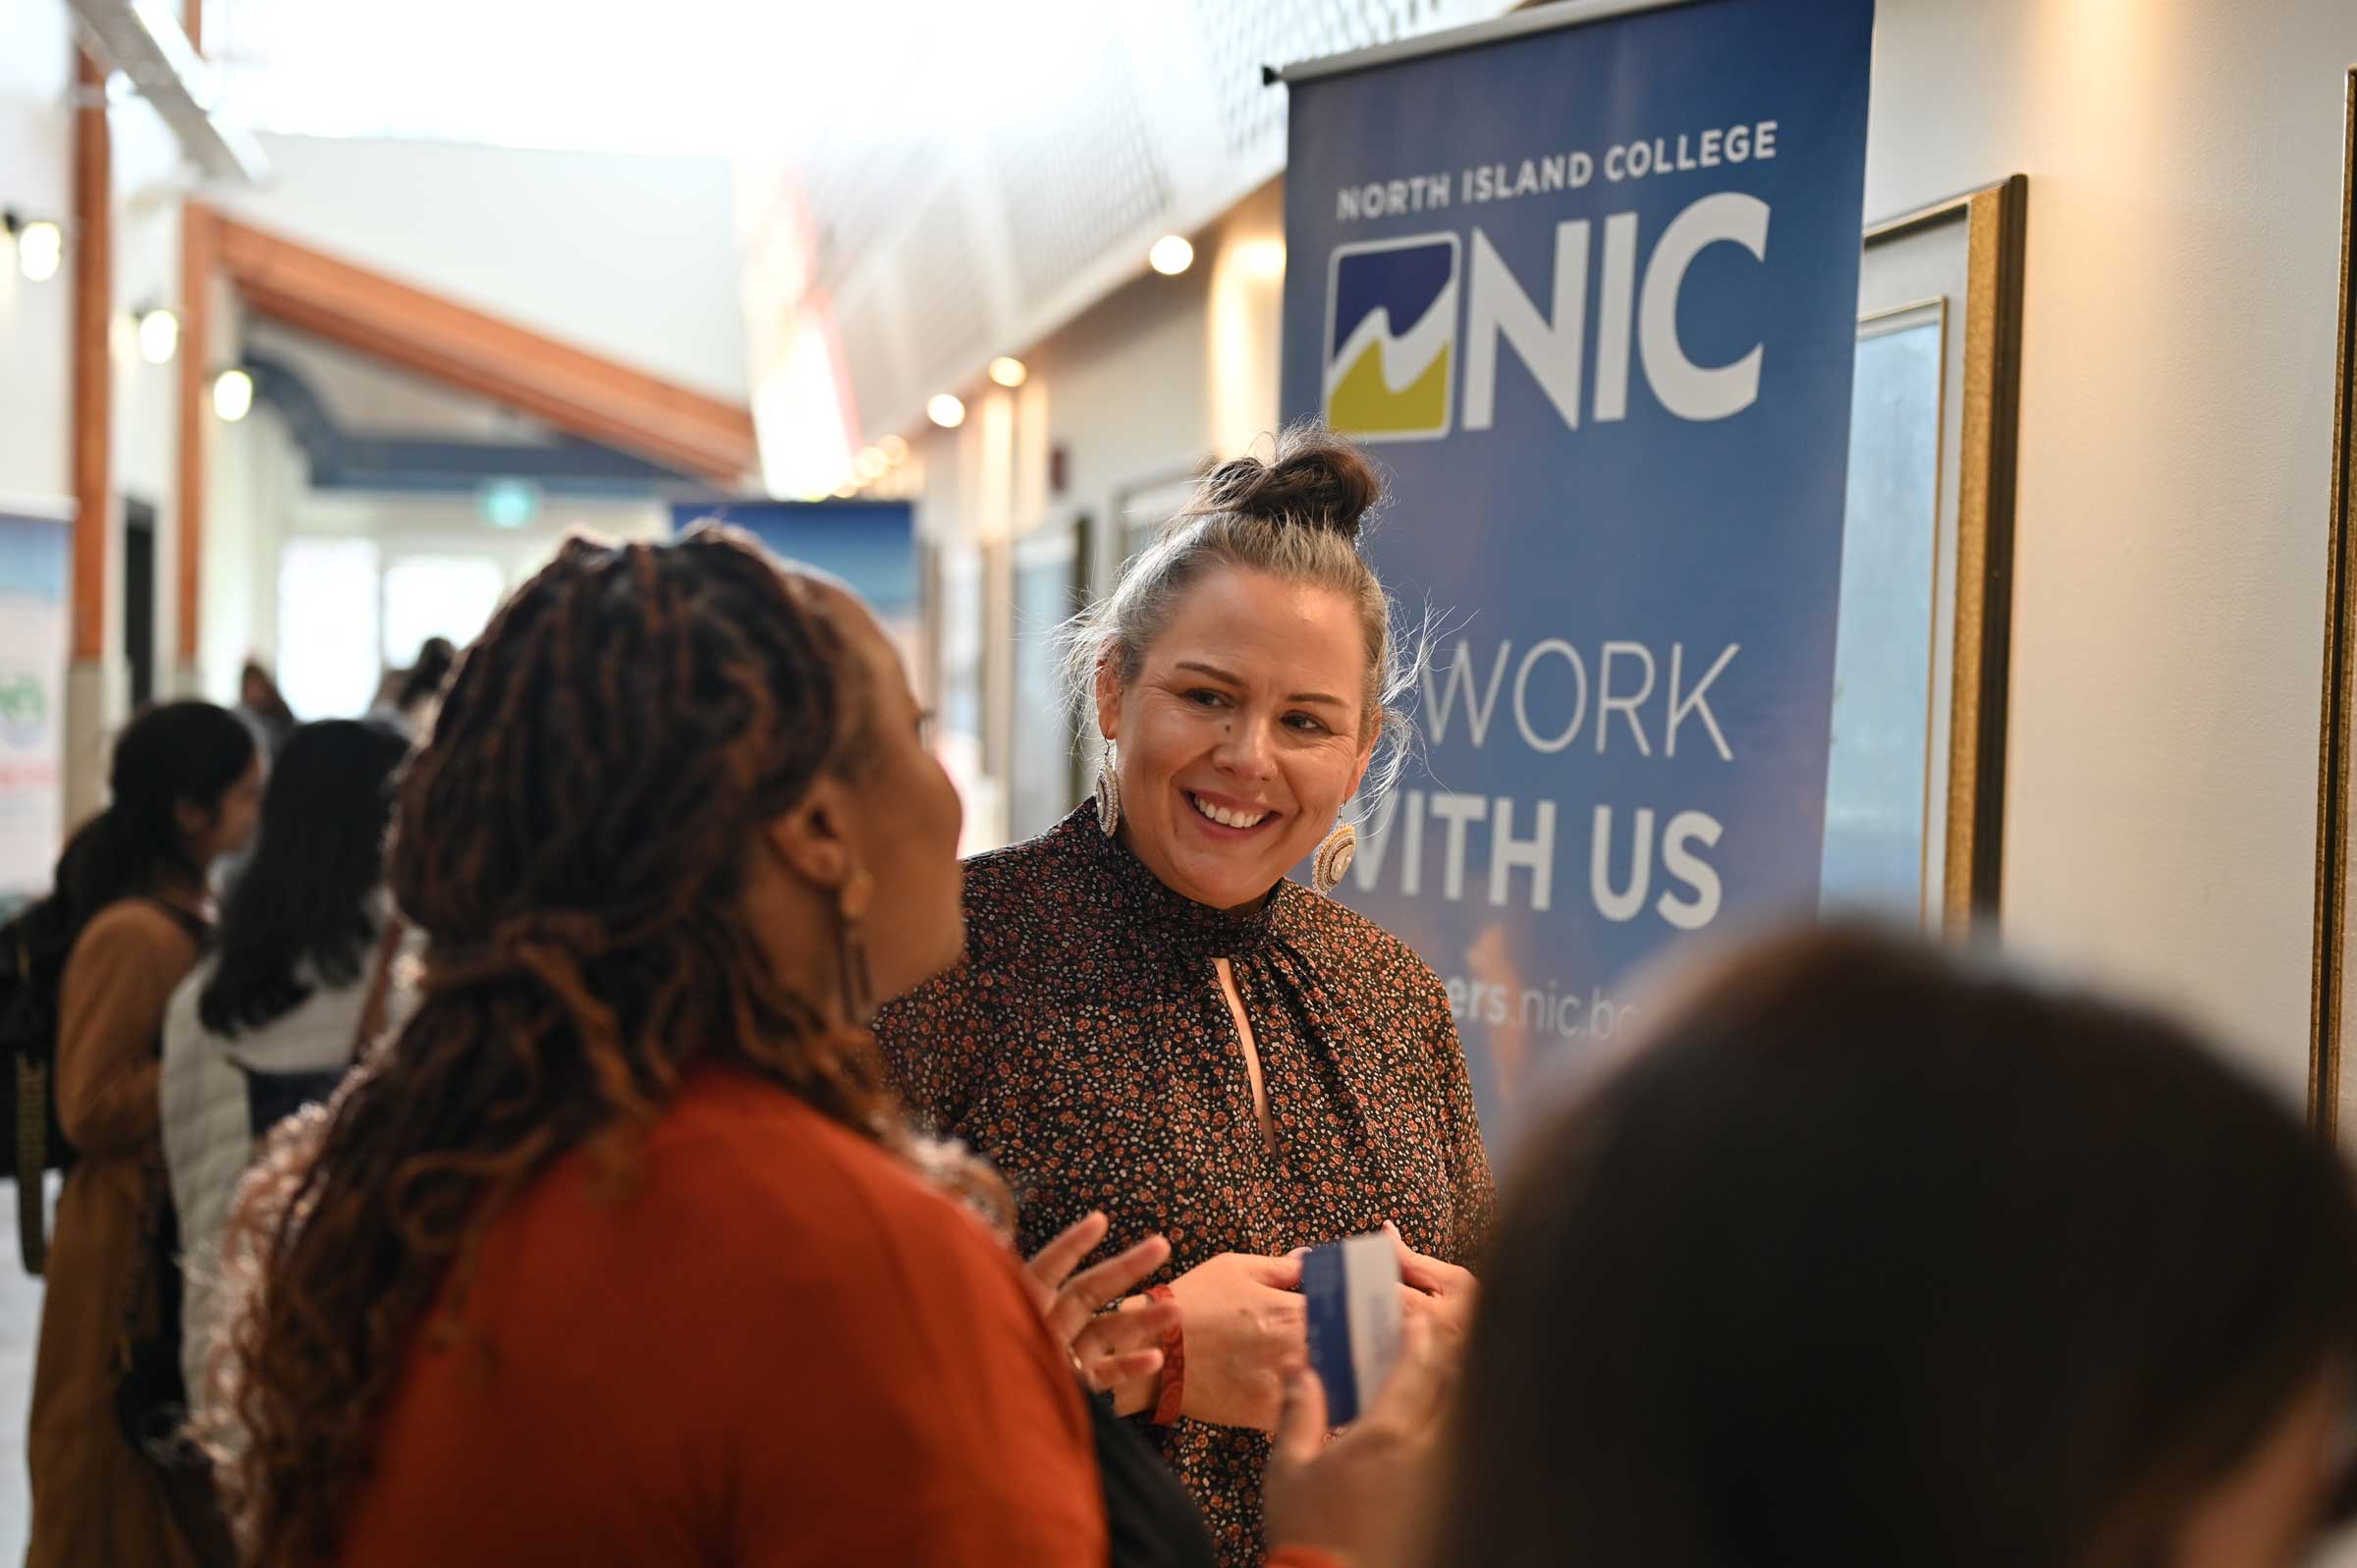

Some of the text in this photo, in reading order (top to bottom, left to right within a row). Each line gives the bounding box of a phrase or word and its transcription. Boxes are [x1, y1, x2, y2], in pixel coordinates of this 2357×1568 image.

[1337, 121, 1778, 222] NORTH ISLAND COLLEGE
[1461, 191, 1771, 432] NIC
[1418, 638, 1740, 762] WORK
[1590, 804, 1724, 930] US
